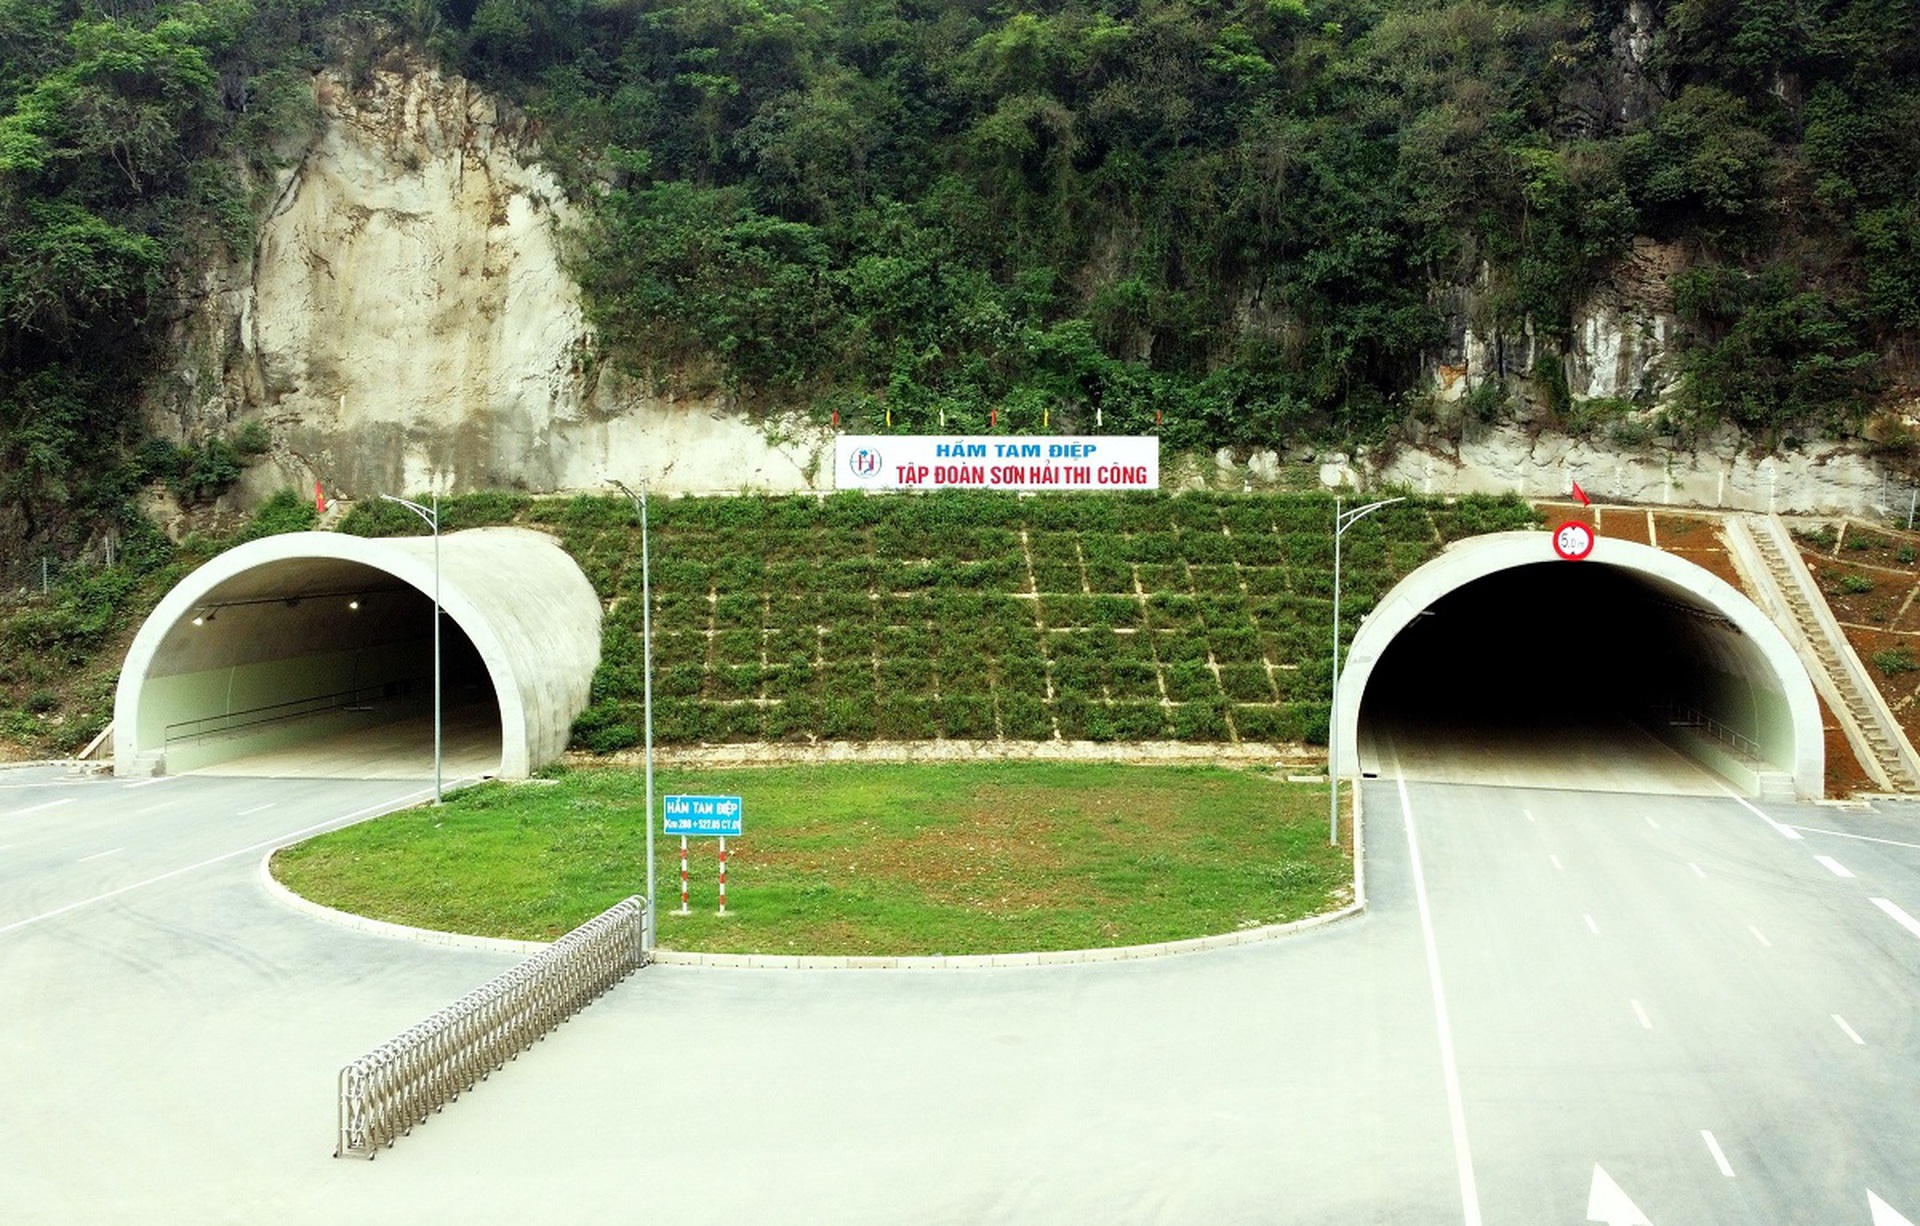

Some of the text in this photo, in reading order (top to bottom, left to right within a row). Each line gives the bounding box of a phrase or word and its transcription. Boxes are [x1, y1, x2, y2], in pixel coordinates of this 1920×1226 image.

[994, 444, 1041, 457] TAM
[1048, 441, 1097, 461] ĐIỆP
[896, 459, 1147, 487] TẬP ĐOÀN SƠN HẢI THI CÔNG
[692, 802, 713, 814] TAM
